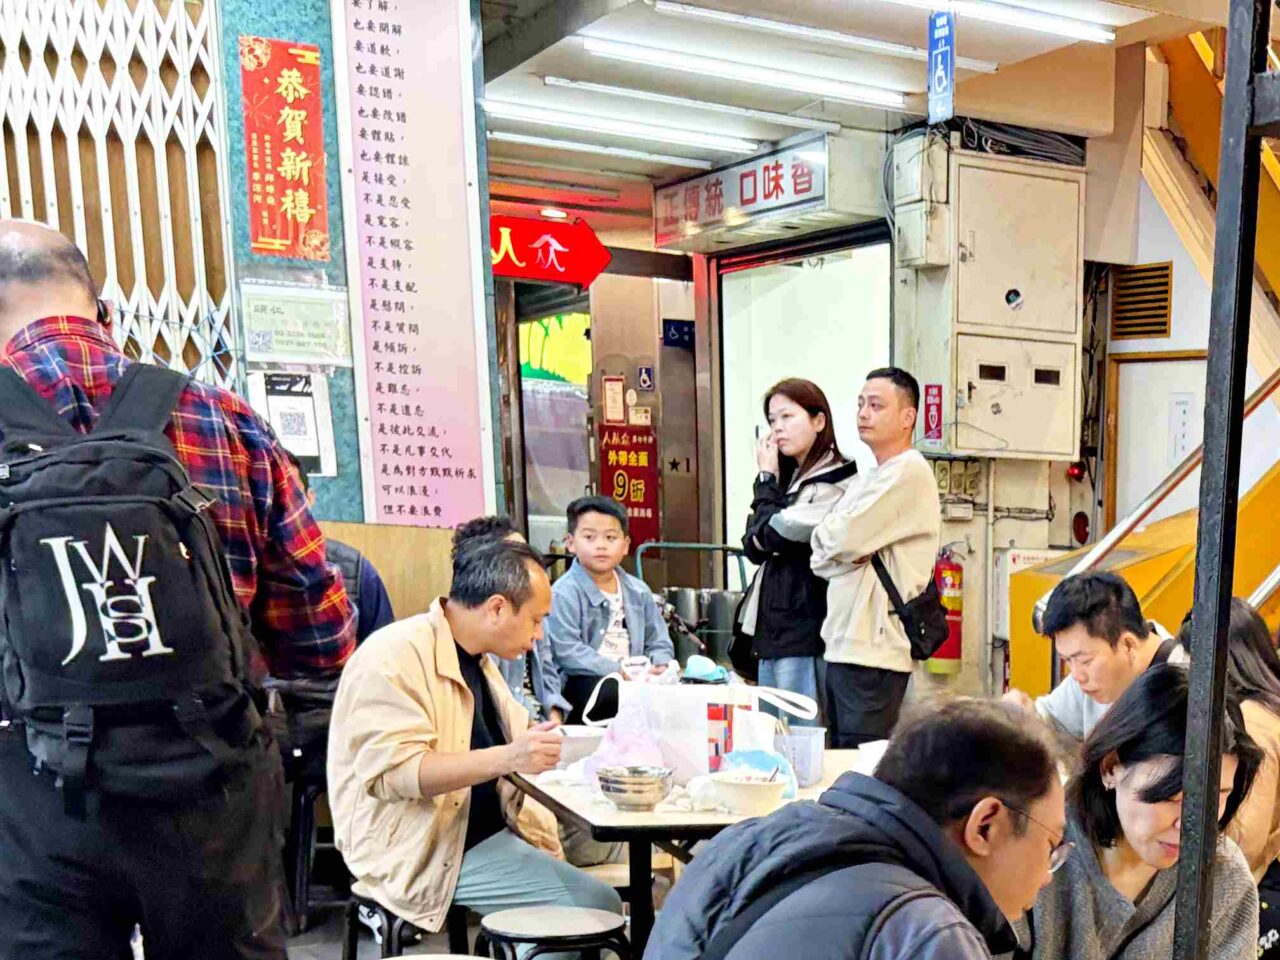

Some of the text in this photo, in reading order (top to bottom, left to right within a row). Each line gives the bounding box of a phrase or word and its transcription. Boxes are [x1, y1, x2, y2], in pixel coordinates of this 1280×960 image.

[355, 62, 405, 80] 也要道謝
[358, 106, 407, 124] 也要改錯
[275, 67, 316, 224] 恭賀新禧
[363, 193, 411, 209] 不是忍受
[368, 278, 418, 293] 不是支配
[371, 320, 419, 335] 不是質問
[374, 361, 422, 376] 不是控訴
[380, 444, 452, 459] 不是凡事交代
[608, 450, 649, 467] 外帶全面
[383, 504, 442, 517] 但不要浪費
